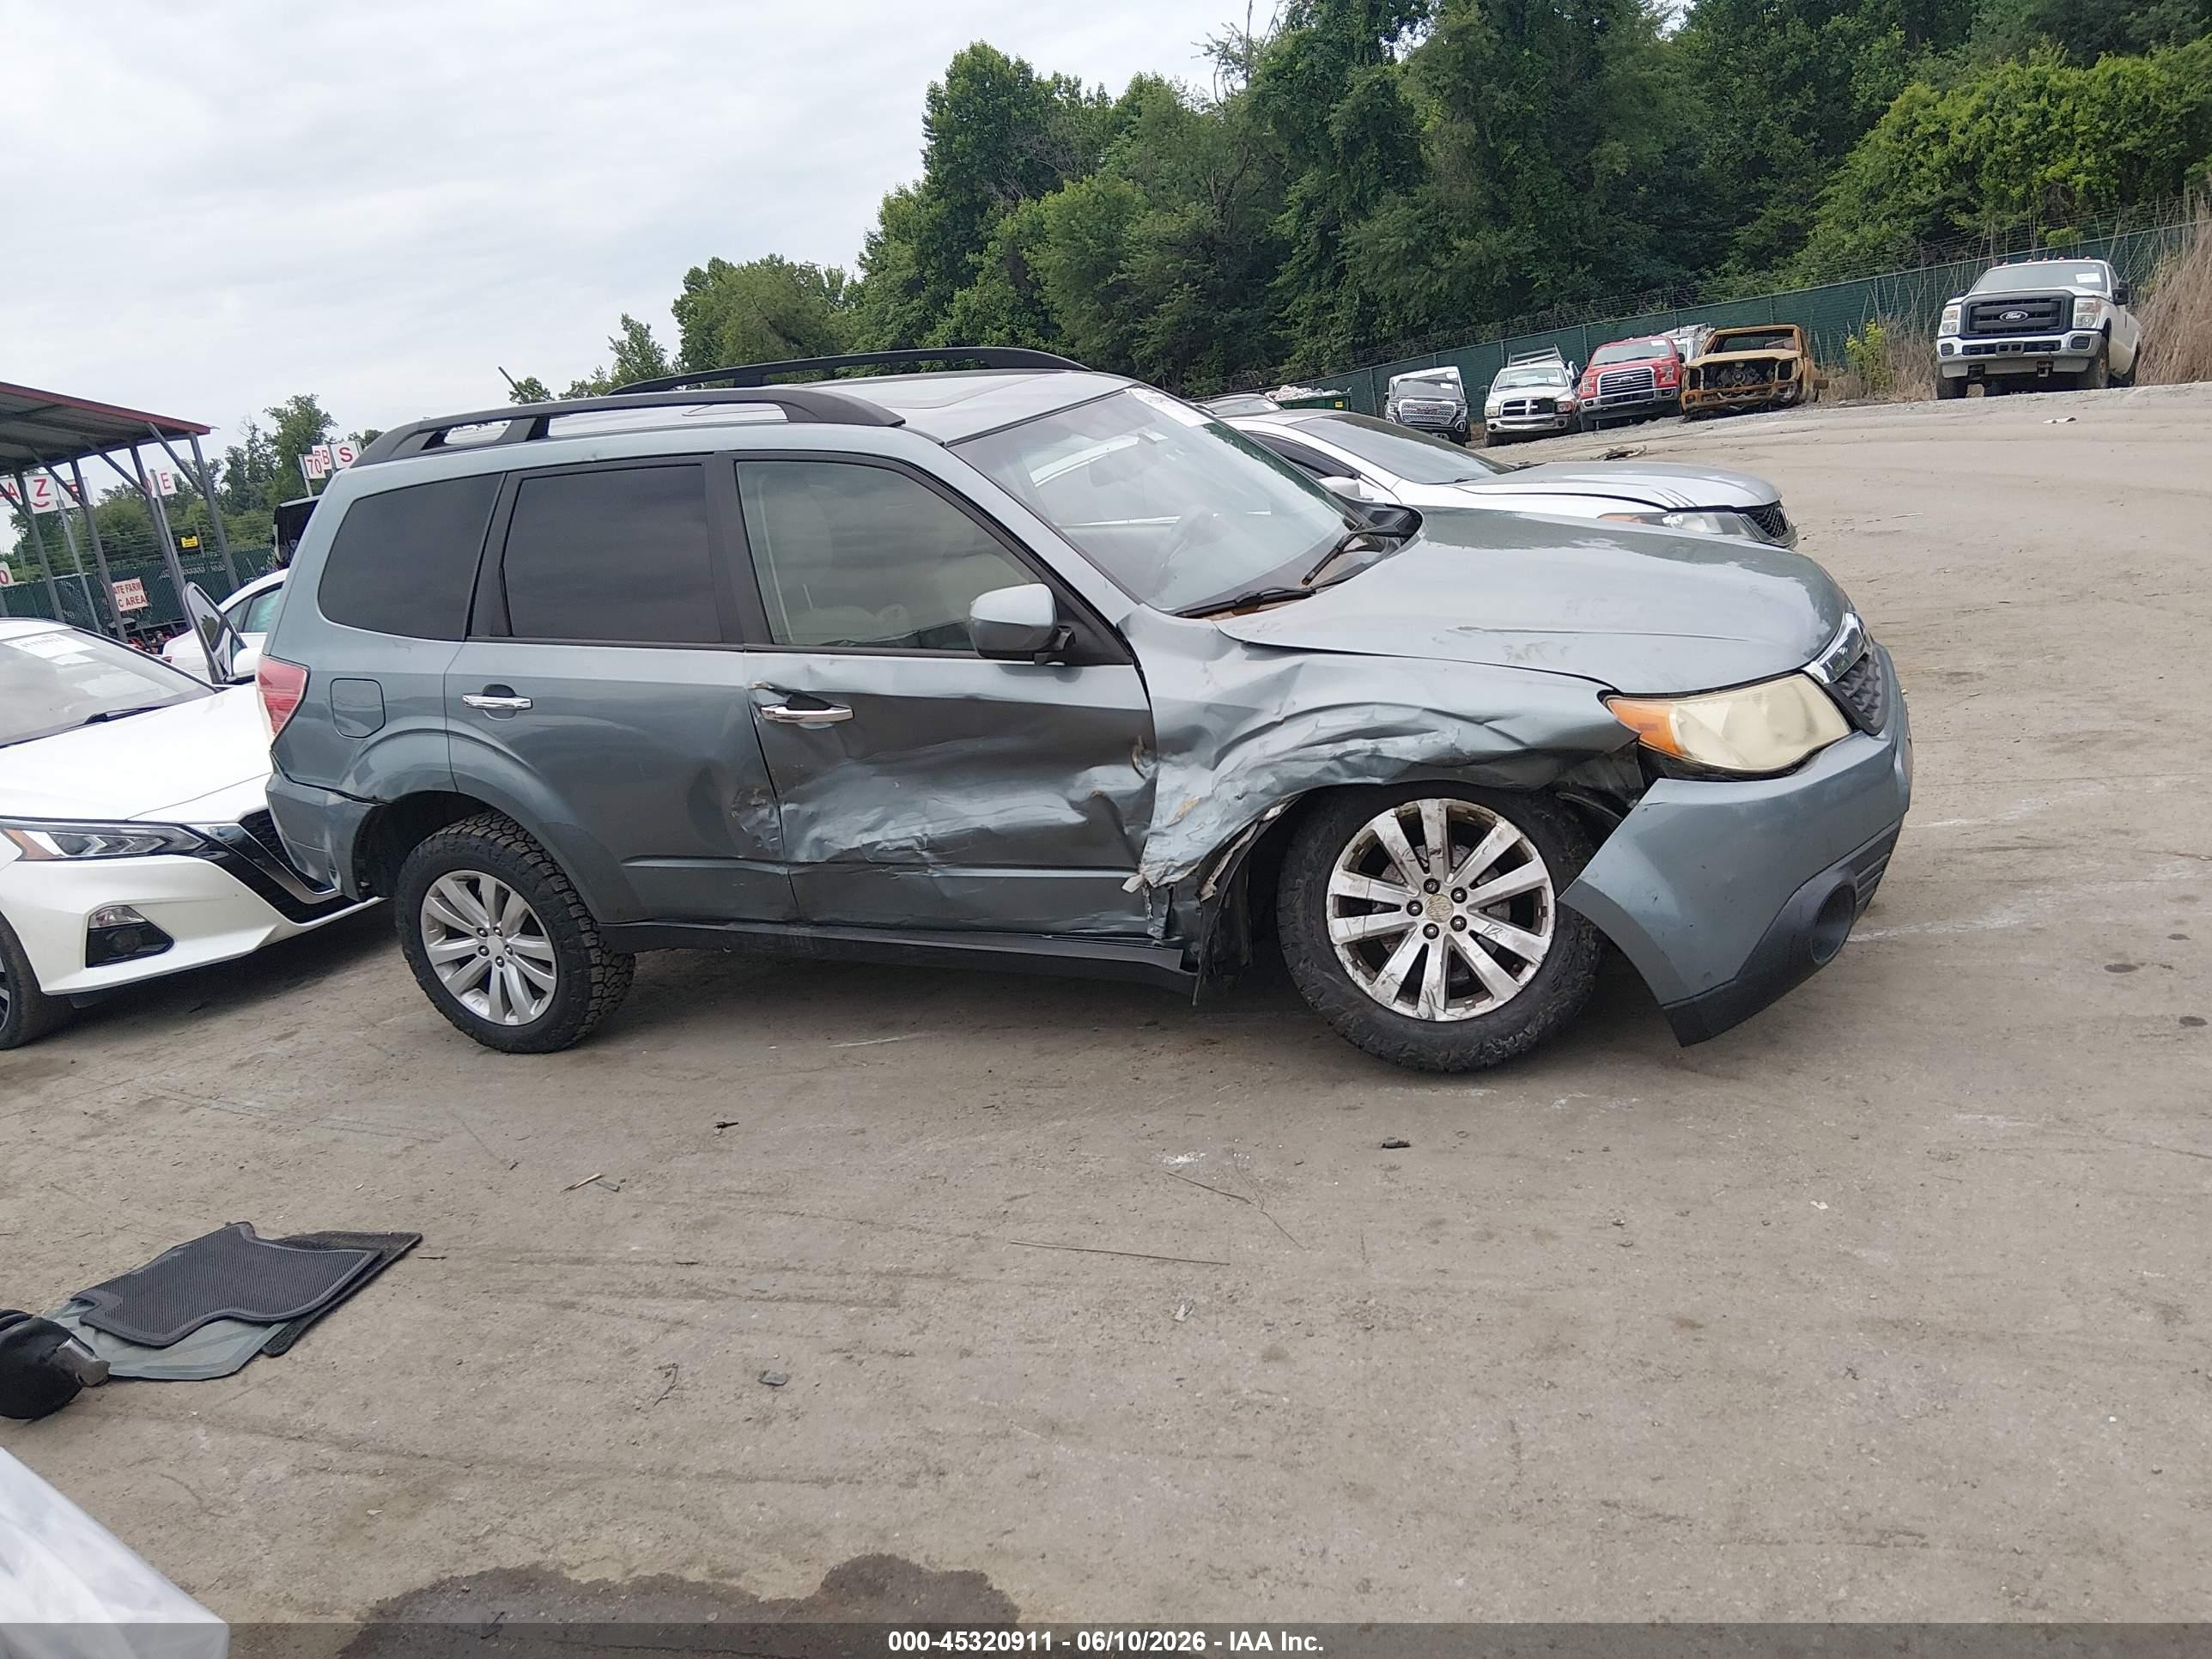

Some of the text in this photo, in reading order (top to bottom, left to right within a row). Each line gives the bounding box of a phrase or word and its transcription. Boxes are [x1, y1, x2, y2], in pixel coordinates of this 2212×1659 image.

[338, 447, 354, 463] S
[307, 458, 323, 475] 70
[33, 478, 52, 497] Z
[160, 472, 172, 489] E
[125, 594, 146, 607] AREA
